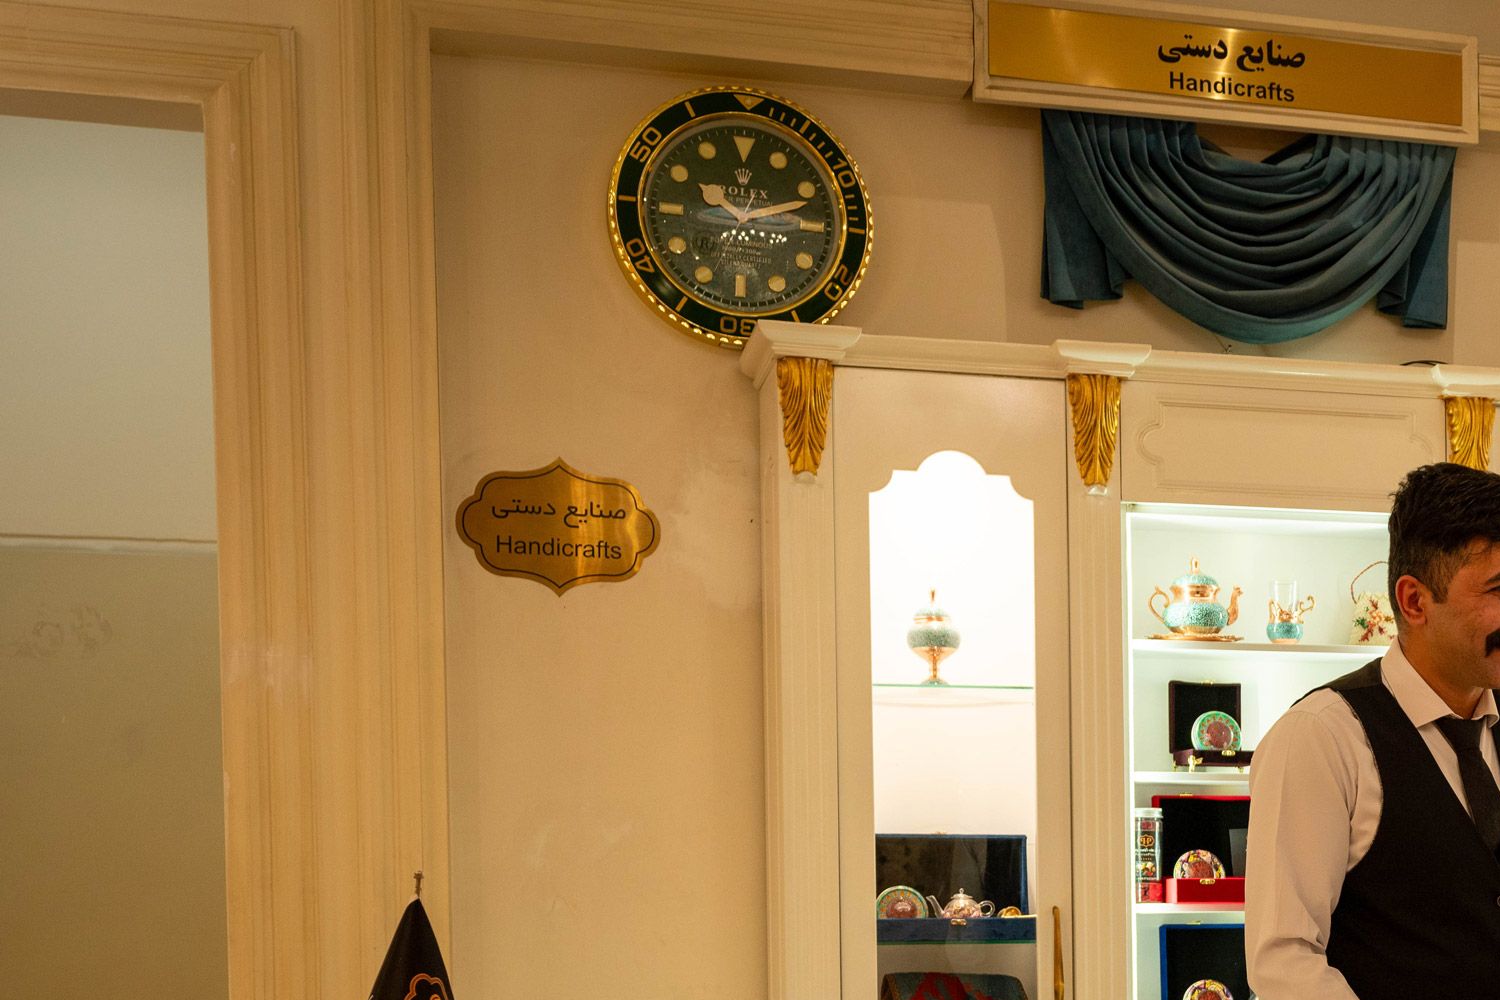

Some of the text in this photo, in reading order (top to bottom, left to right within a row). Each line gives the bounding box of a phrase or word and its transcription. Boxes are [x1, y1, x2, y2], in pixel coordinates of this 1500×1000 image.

[1157, 33, 1306, 72] صنایع دستی
[1169, 71, 1295, 102] Handicrafts
[629, 126, 662, 163] 50
[831, 157, 856, 189] 10
[624, 239, 655, 274] 40
[824, 266, 853, 301] 20
[491, 498, 626, 529] صنایع دستی
[496, 535, 622, 560] Handicrafts
